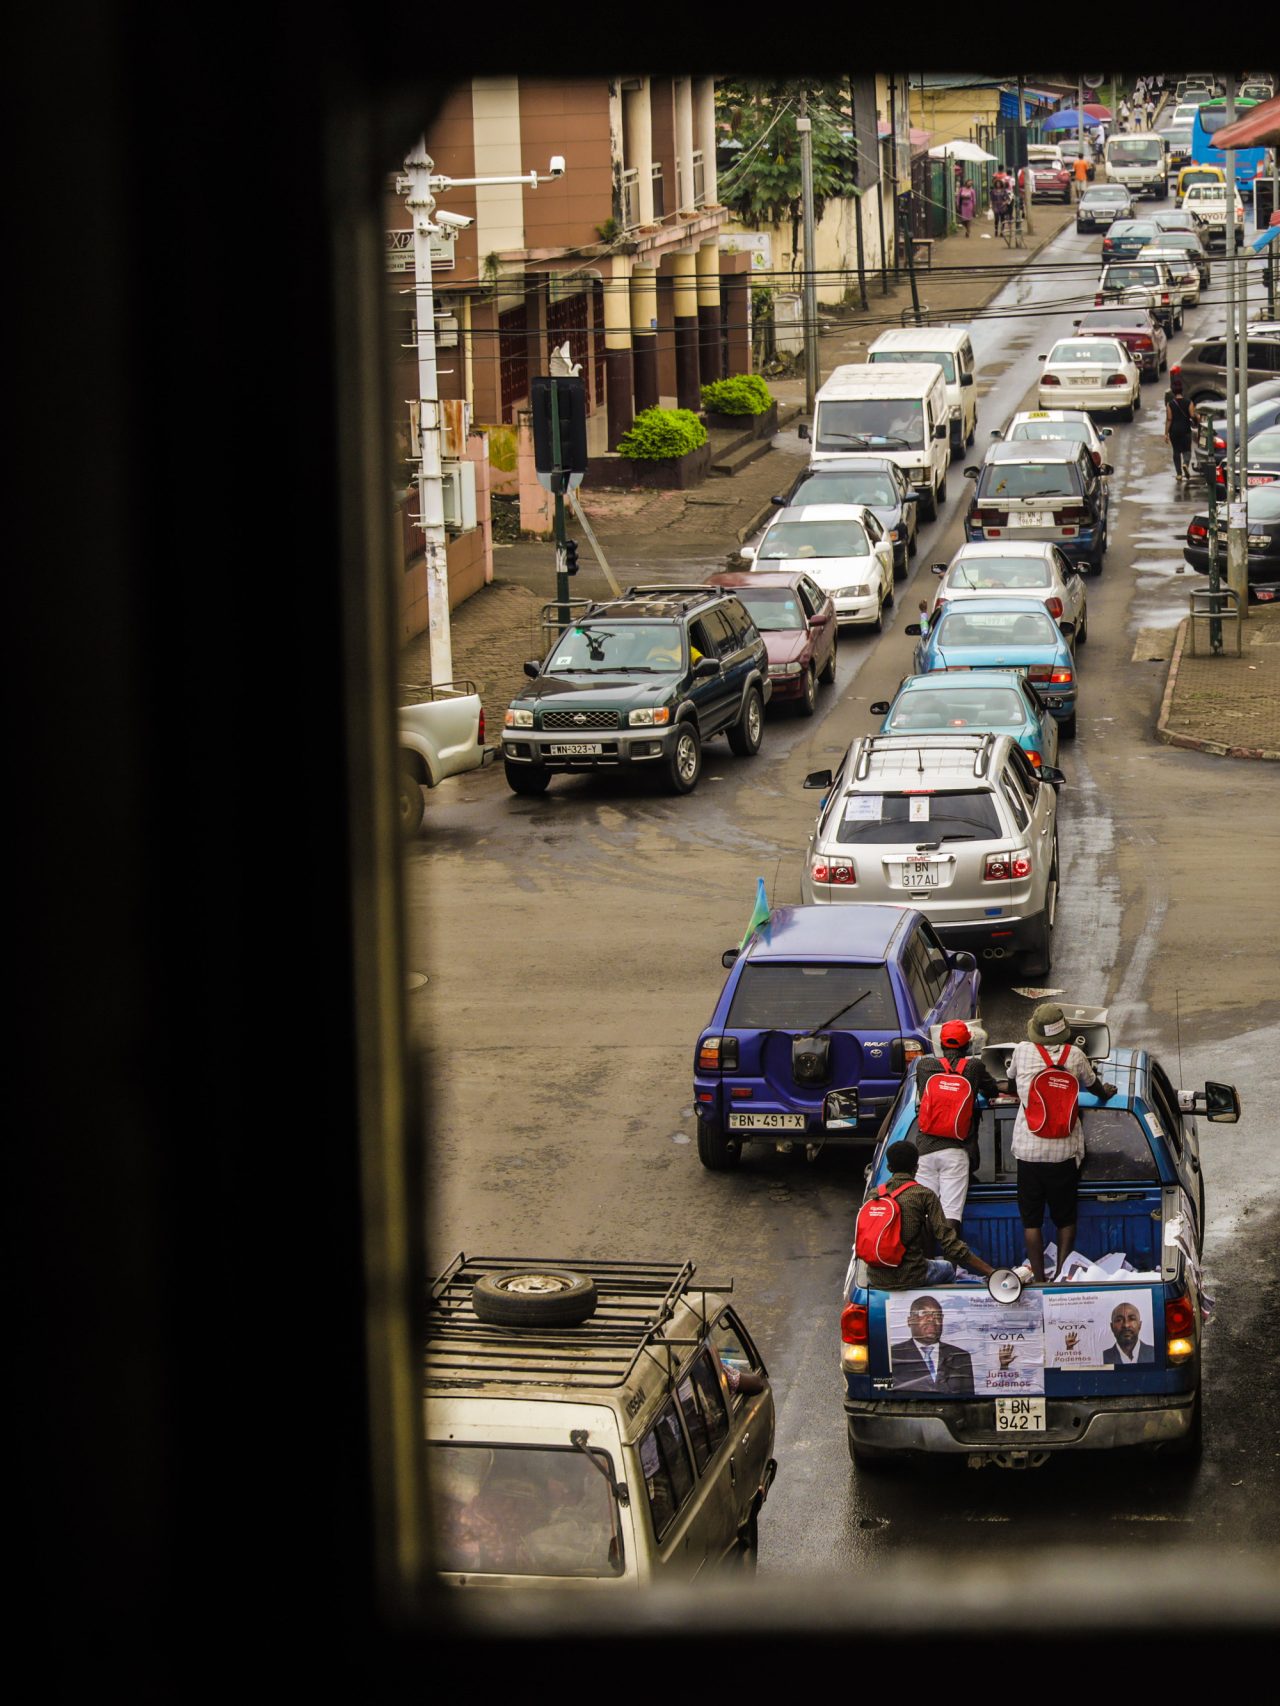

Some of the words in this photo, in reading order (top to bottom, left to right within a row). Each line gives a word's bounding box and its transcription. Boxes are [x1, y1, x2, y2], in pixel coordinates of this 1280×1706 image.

[915, 862, 929, 872] BN
[990, 1333, 1025, 1341] VOTA
[985, 1369, 1020, 1379] Juntos
[985, 1379, 1031, 1388] Podemos
[1011, 1399, 1030, 1414] BN
[999, 1415, 1029, 1430] 942
[1033, 1415, 1043, 1430] T
